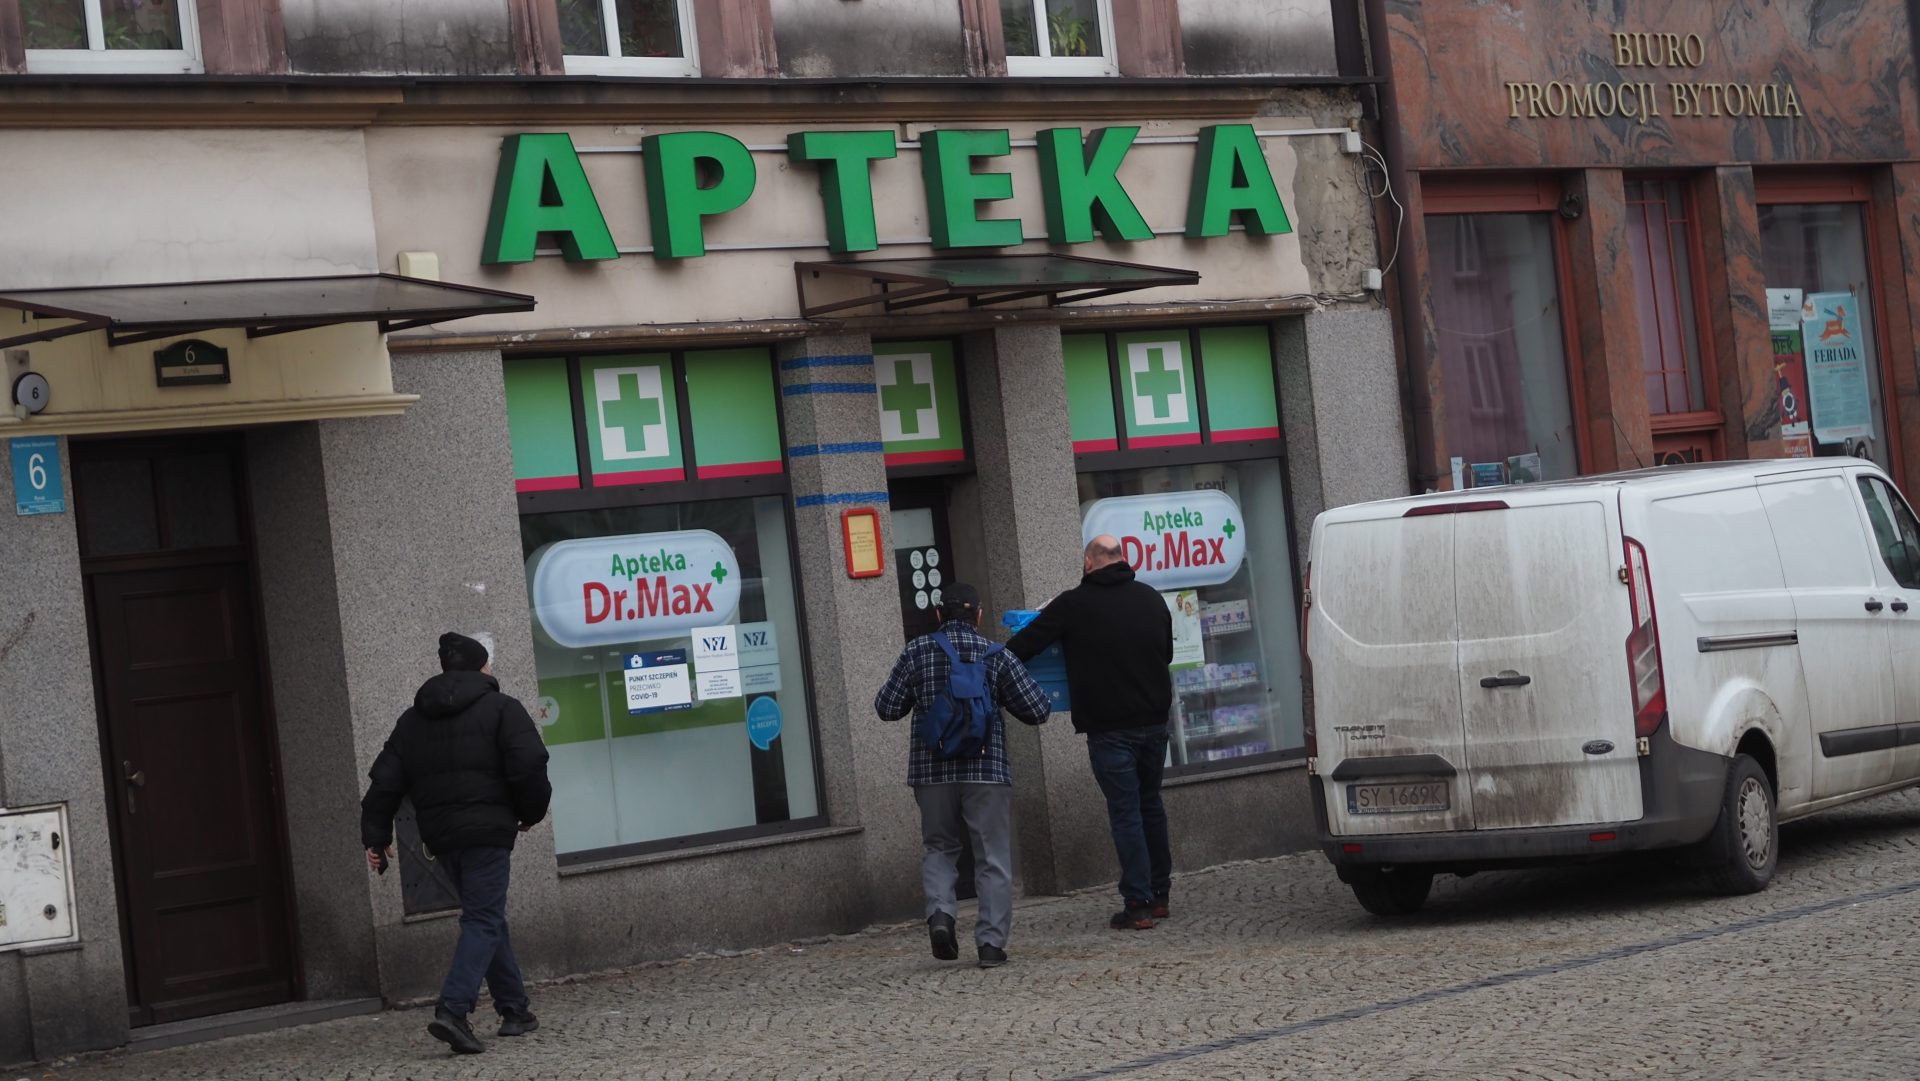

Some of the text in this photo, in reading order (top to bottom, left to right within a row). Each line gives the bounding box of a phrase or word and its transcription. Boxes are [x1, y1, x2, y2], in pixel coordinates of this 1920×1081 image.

[1612, 31, 1705, 68] BIURO
[1506, 81, 1803, 124] PROMOCJI BYTOMIA
[481, 123, 1293, 266] APTEKA
[185, 344, 196, 364] 6
[1814, 347, 1857, 364] FERIADA
[32, 386, 40, 400] 6
[29, 453, 47, 490] 6
[1143, 507, 1203, 536] Apteka
[1121, 531, 1226, 573] Dr.Max
[611, 548, 687, 581] Apteka
[583, 575, 715, 625] Dr.Max
[702, 636, 727, 652] NFZ
[743, 631, 768, 647] NFZ
[629, 675, 648, 683] PUNKT
[630, 691, 658, 701] COVID-19
[1333, 724, 1386, 732] TRANSIT
[1359, 784, 1442, 808] SY 1669K
